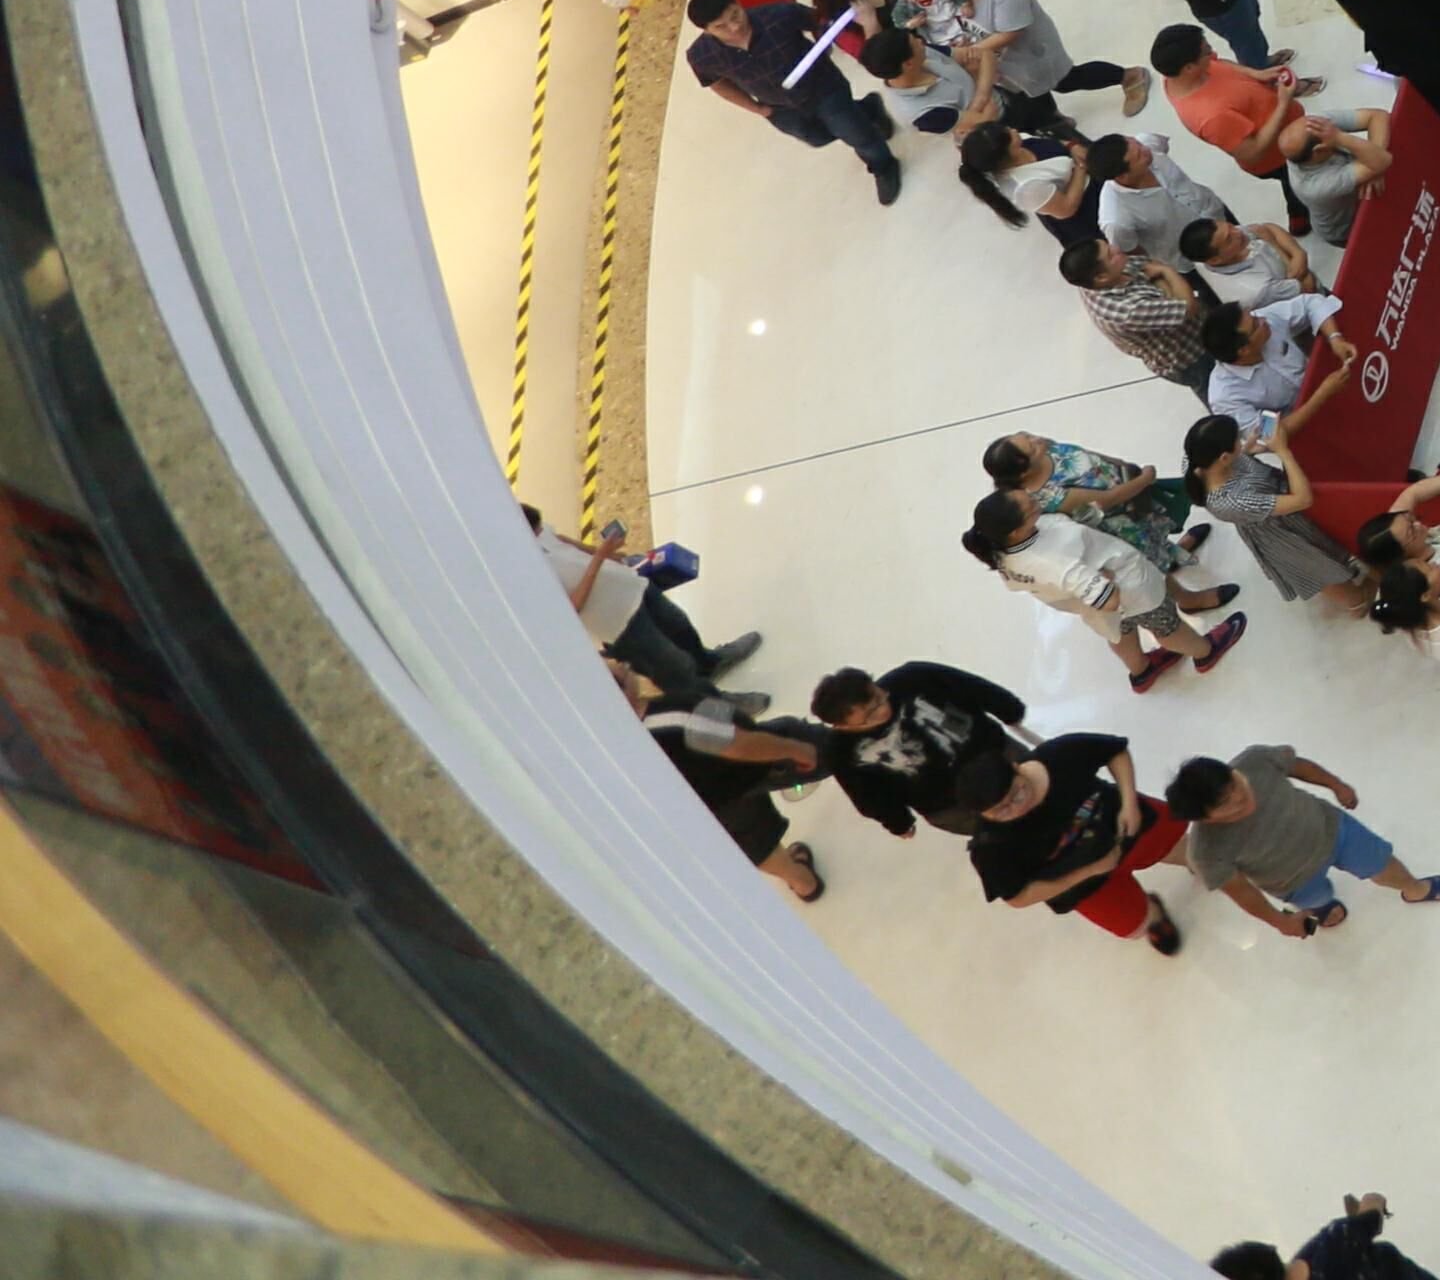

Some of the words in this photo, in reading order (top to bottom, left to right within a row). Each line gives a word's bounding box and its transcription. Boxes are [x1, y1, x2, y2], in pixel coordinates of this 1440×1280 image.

[1375, 186, 1436, 346] 万达广场
[1390, 273, 1423, 351] WANDA
[1415, 205, 1440, 272] PLAZA
